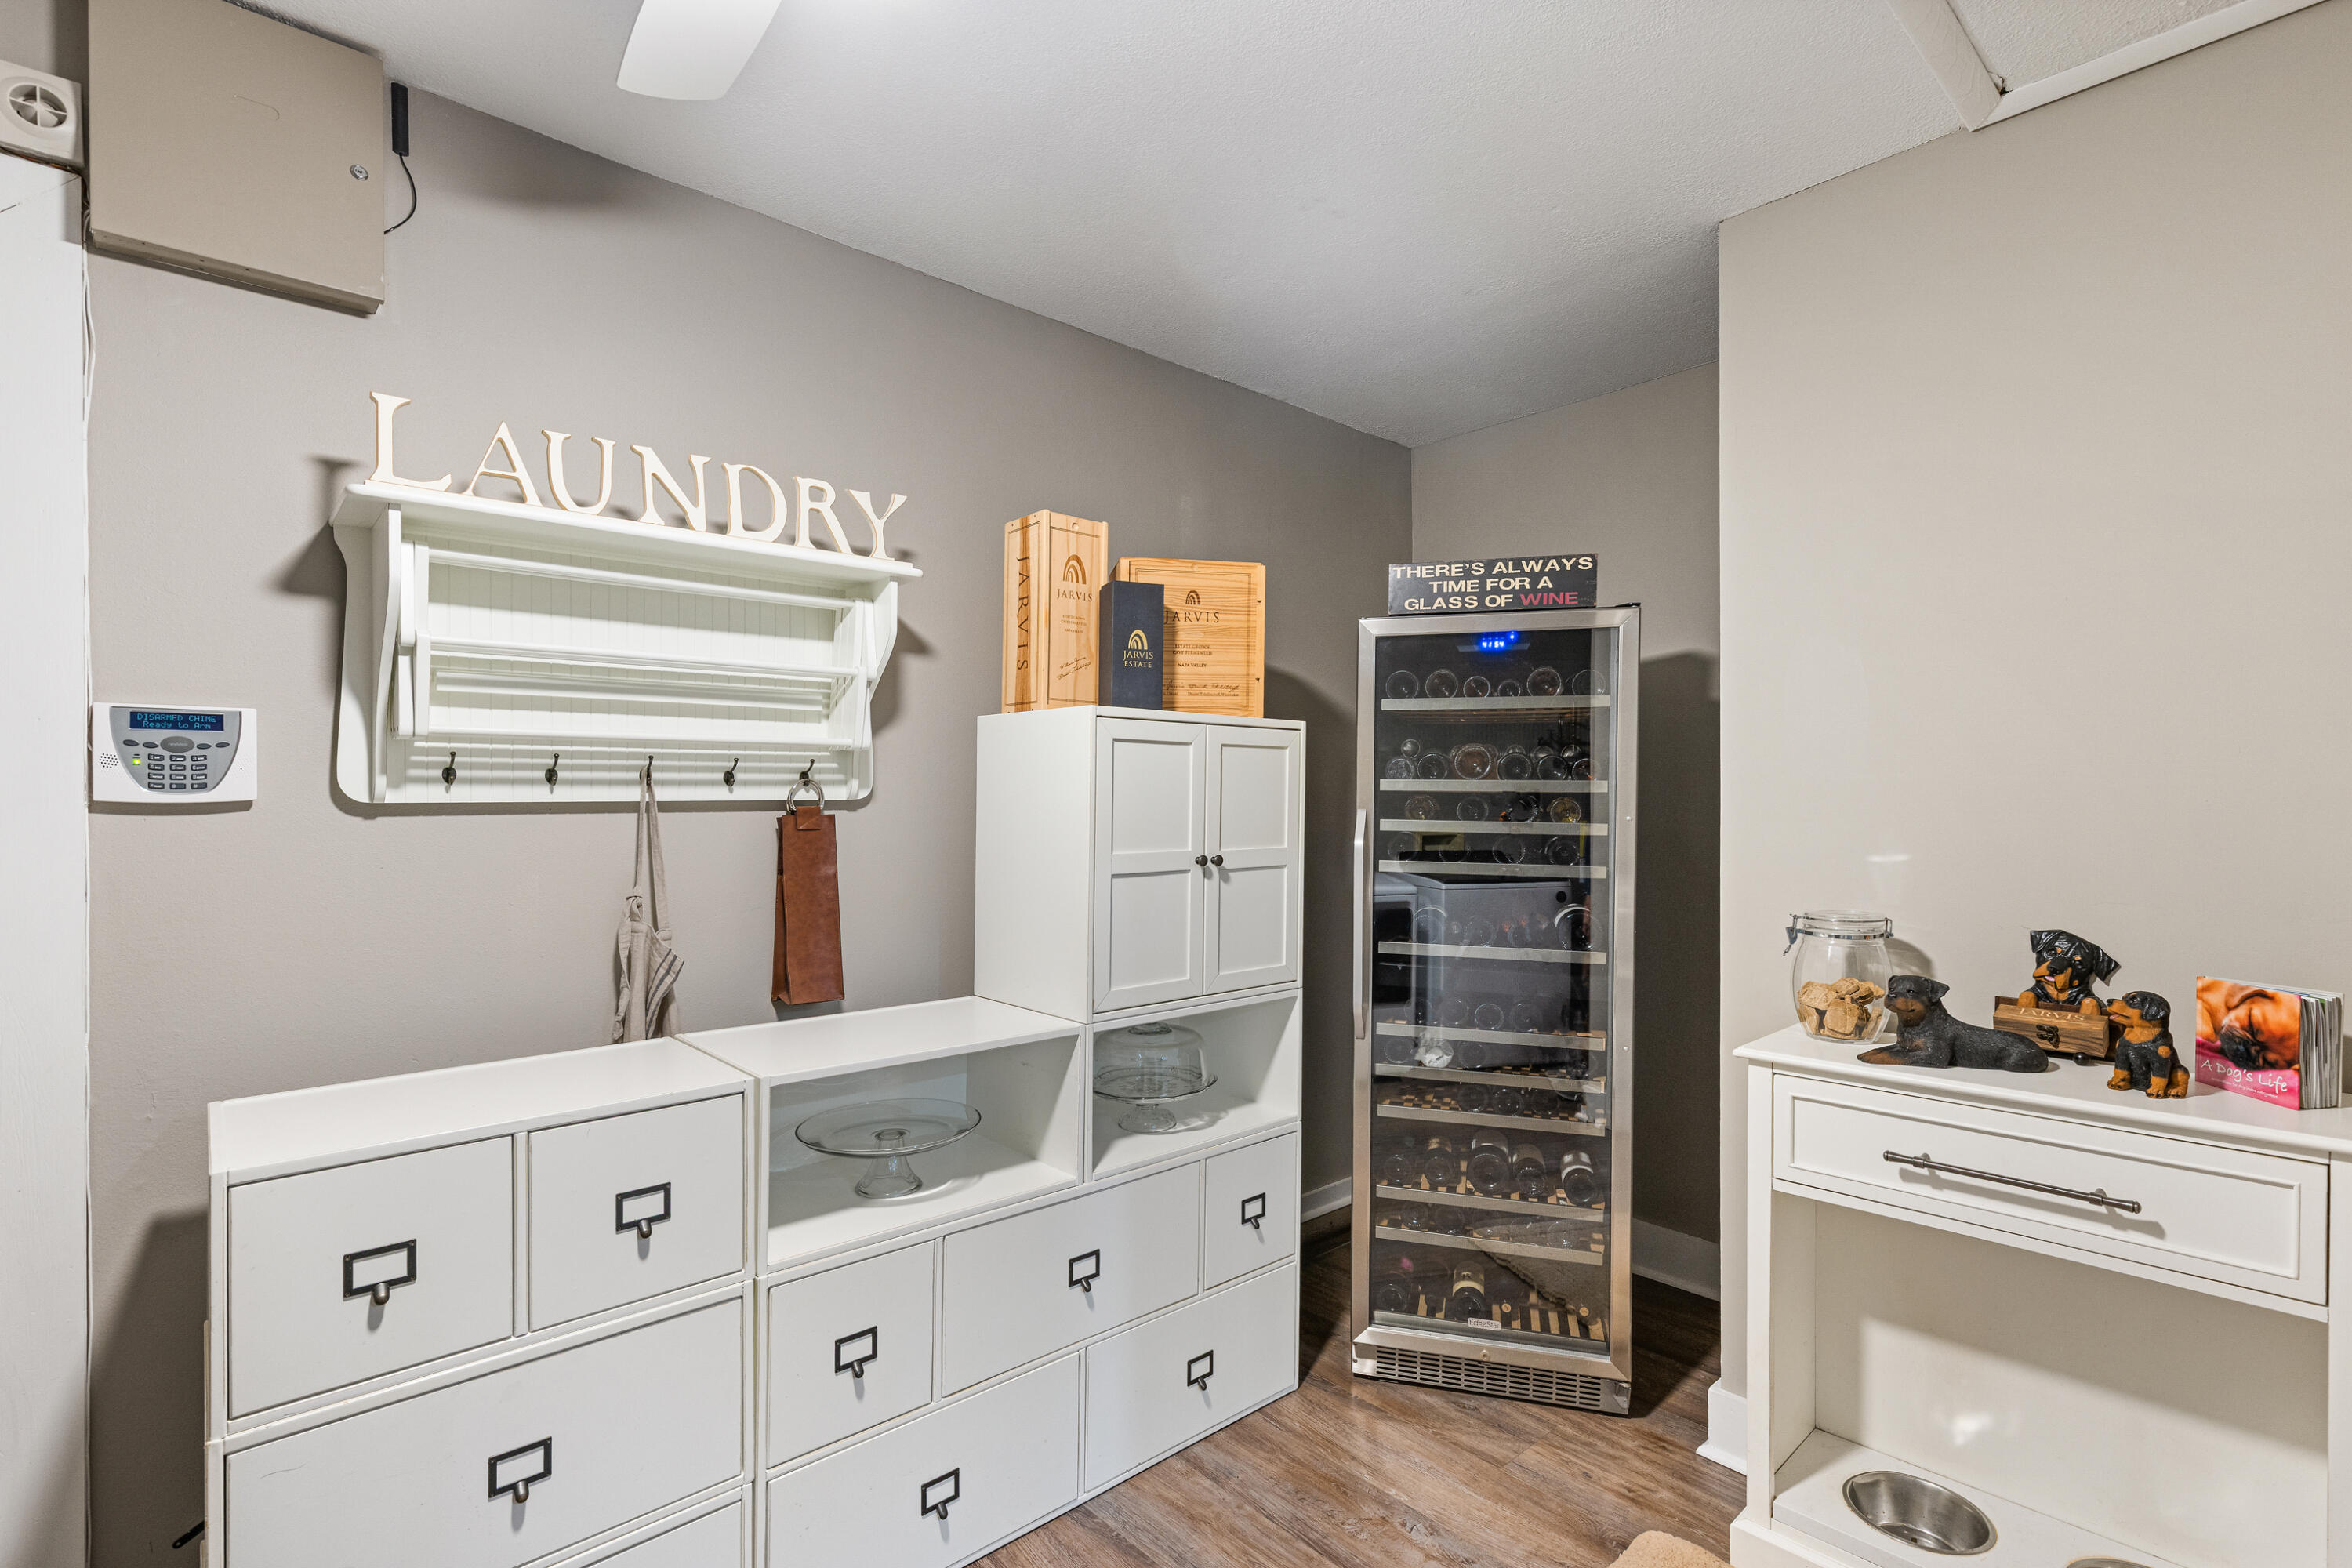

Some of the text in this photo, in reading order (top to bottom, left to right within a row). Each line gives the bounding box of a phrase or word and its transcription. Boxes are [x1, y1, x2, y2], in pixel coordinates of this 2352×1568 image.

[368, 390, 908, 561] LAUNDRY
[1392, 556, 1593, 579] THERE'S ALWAYS
[1428, 575, 1553, 593] TIME FOR A
[1057, 588, 1093, 602] JARVIS
[1404, 591, 1579, 611] GLASS OF WINE
[1016, 555, 1029, 670] JARVIS
[1163, 610, 1220, 625] JARVIS
[1123, 650, 1154, 662] JARVIS
[1124, 660, 1152, 669] ESTATE
[136, 713, 216, 723] DISARMED CHIME
[2020, 1007, 2086, 1021] JARVIS
[2201, 1059, 2288, 1094] A Dog's Life
